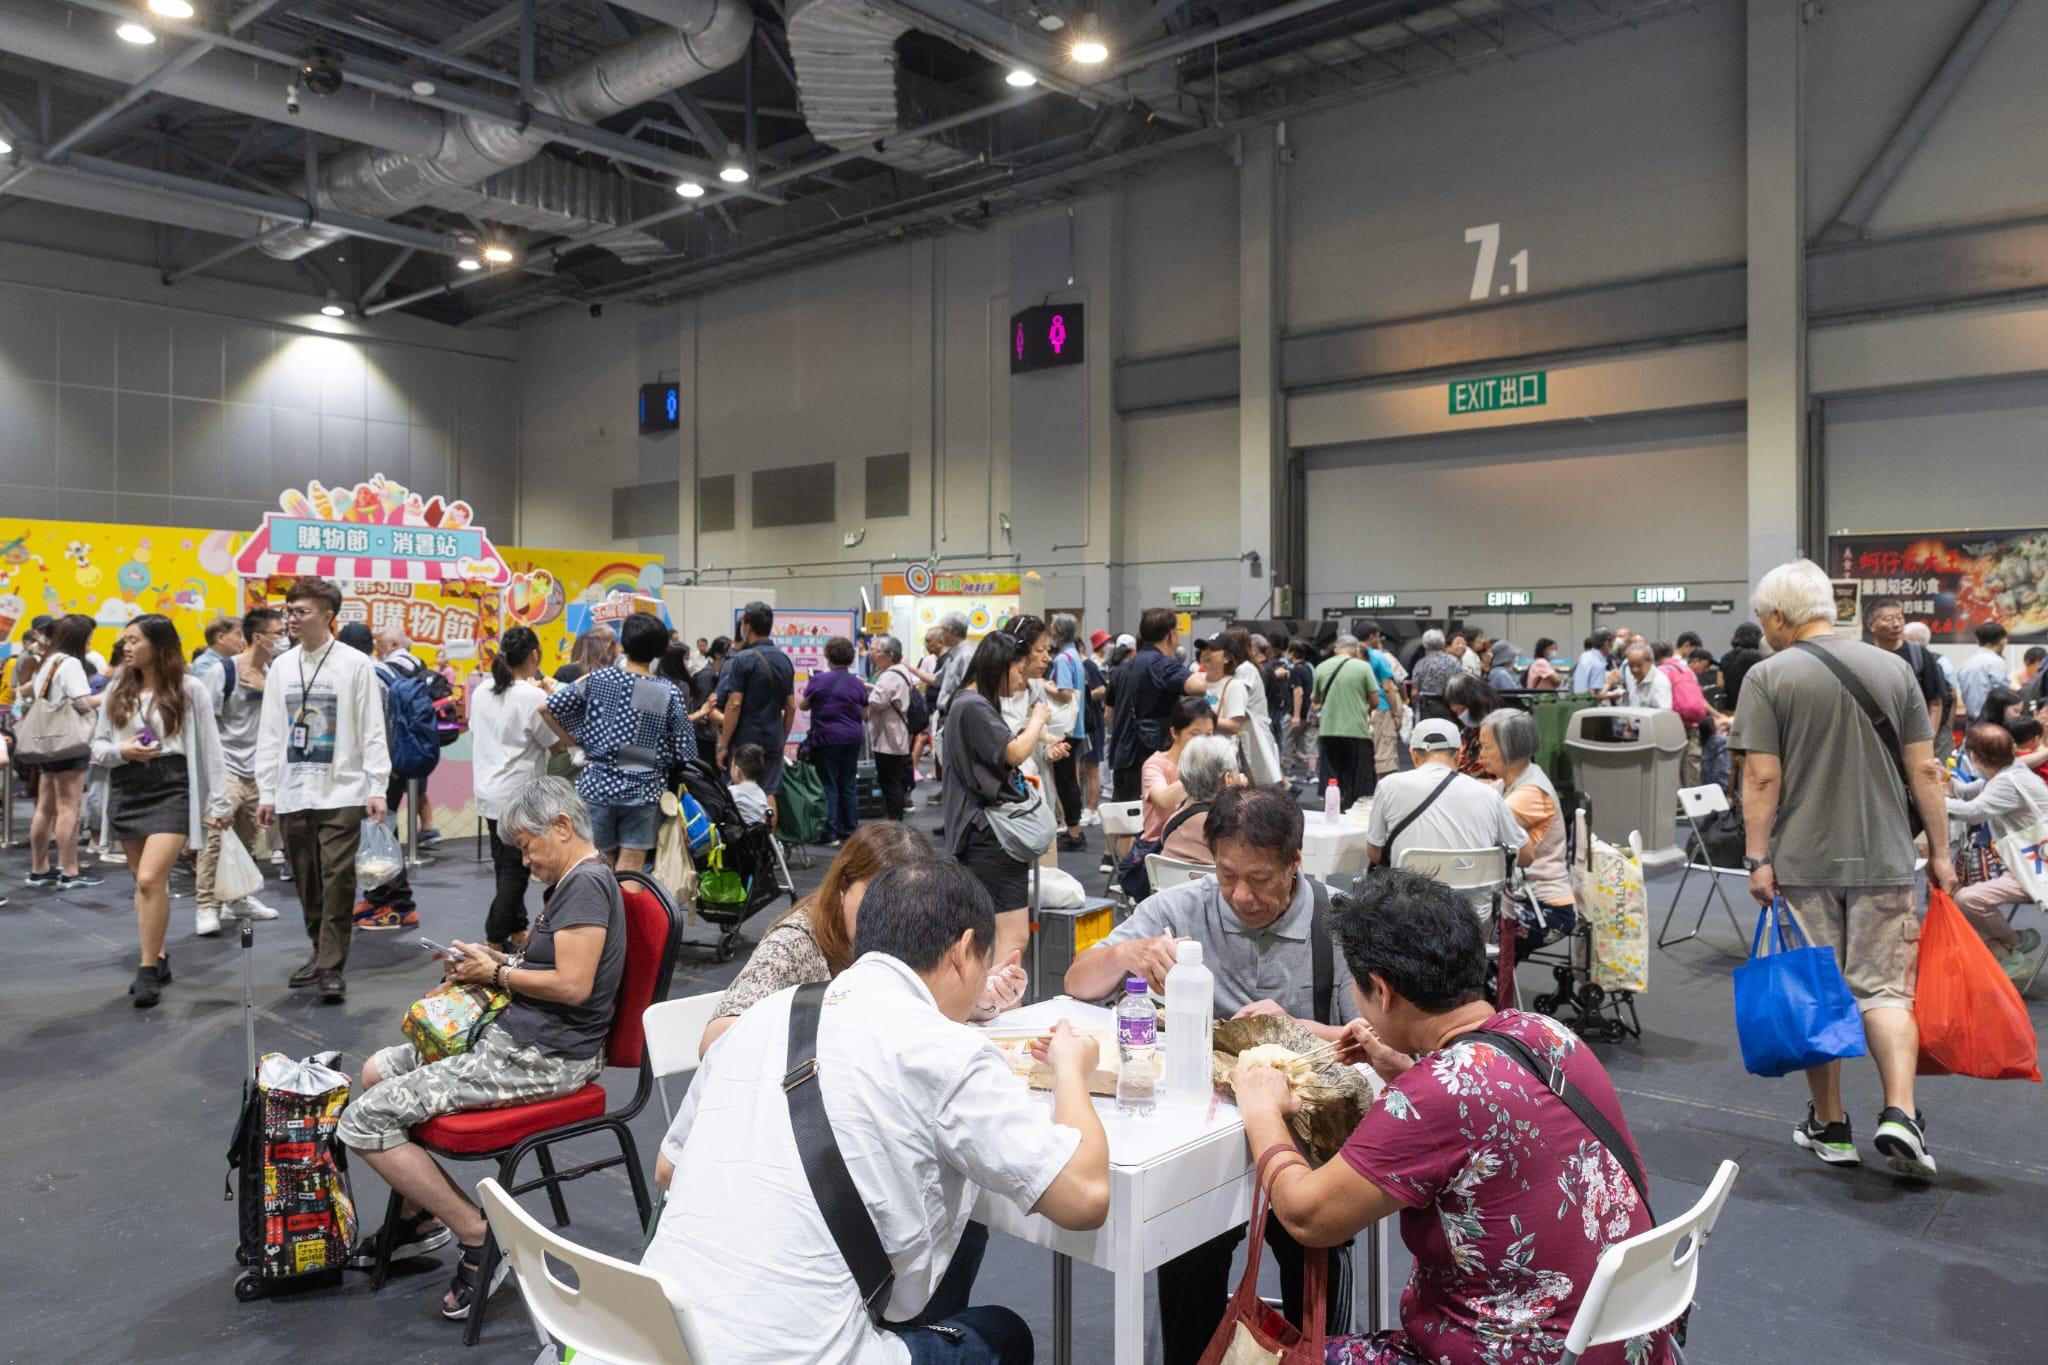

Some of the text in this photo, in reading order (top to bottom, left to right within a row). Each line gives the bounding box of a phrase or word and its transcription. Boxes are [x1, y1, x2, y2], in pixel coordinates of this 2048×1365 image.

[1465, 223, 1528, 301] 7.1
[1456, 375, 1538, 411] EXIT 出口
